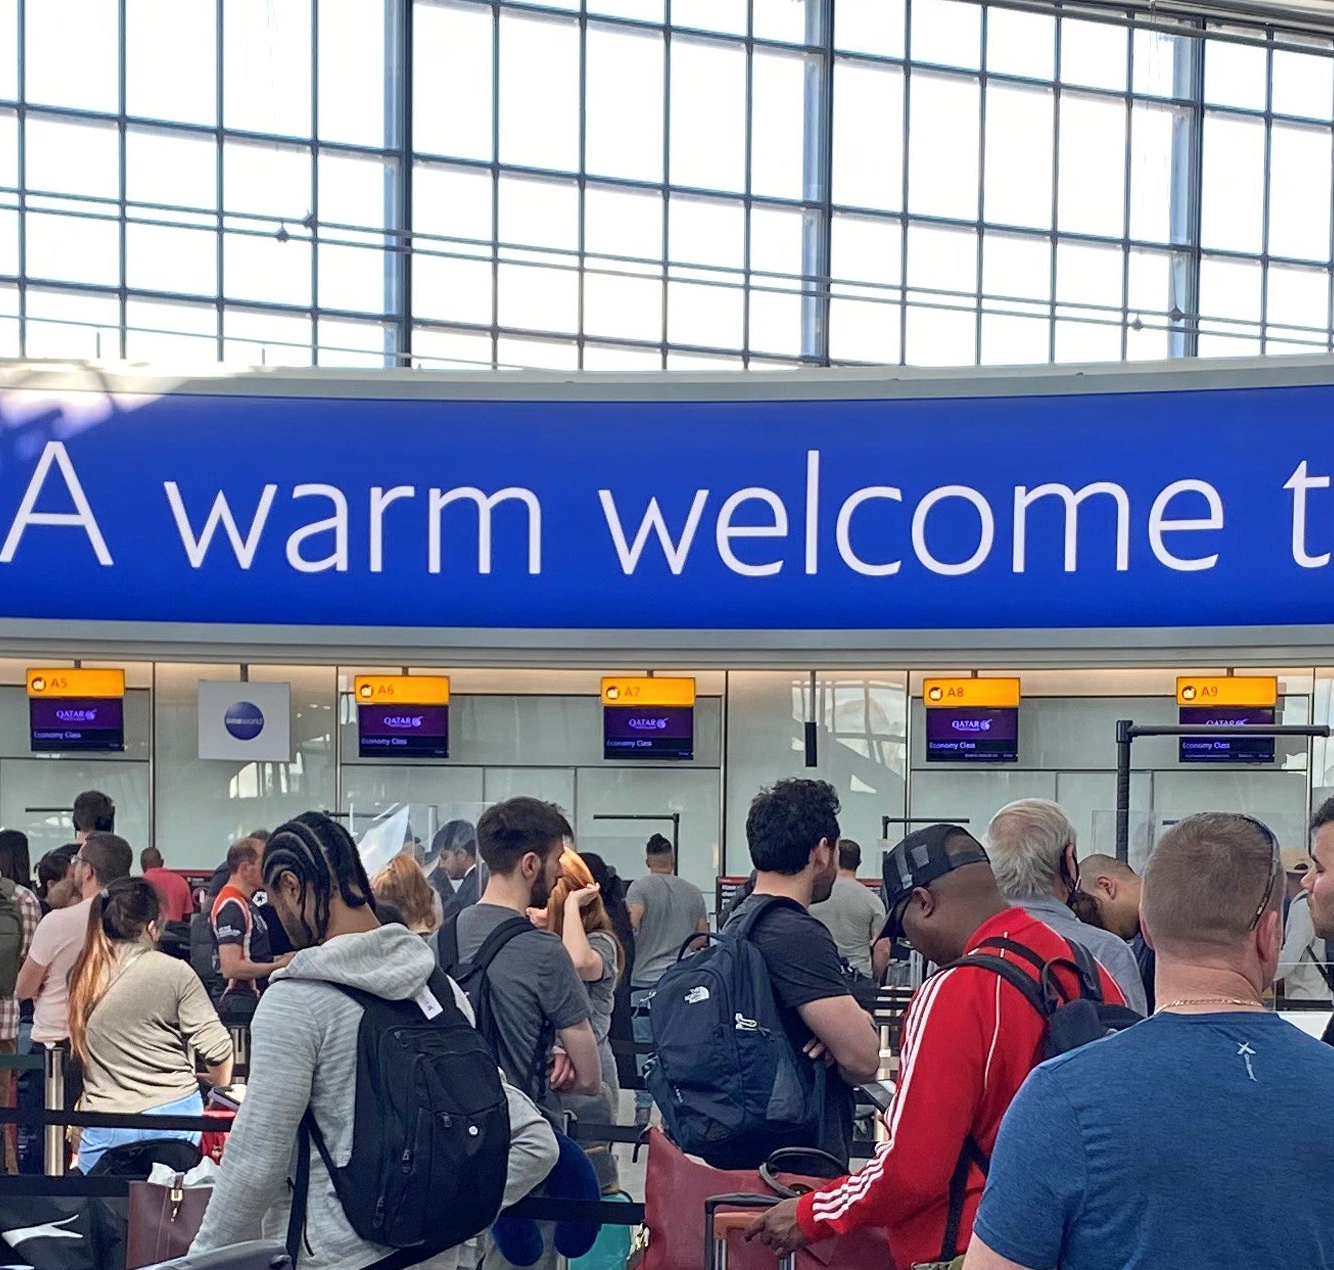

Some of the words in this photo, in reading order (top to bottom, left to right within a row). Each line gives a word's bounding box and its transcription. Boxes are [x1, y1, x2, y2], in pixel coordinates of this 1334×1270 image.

[162, 480, 543, 575] warm
[598, 449, 1225, 576] welcome
[51, 677, 68, 689] A5
[378, 685, 395, 695] A6
[624, 687, 640, 697] A7
[947, 687, 964, 697] A8
[1201, 686, 1217, 697] A9
[56, 709, 84, 720] QATAR
[384, 716, 411, 727] QATAR
[628, 718, 656, 728] QATAR
[952, 719, 980, 730] QATAR
[361, 738, 390, 747] Economy
[392, 737, 407, 745] Class
[607, 739, 635, 748] Economy
[637, 739, 652, 747] Class
[929, 742, 957, 751] Economy
[958, 741, 975, 749] Class
[1182, 741, 1212, 751] Economy
[1213, 741, 1230, 749] Class
